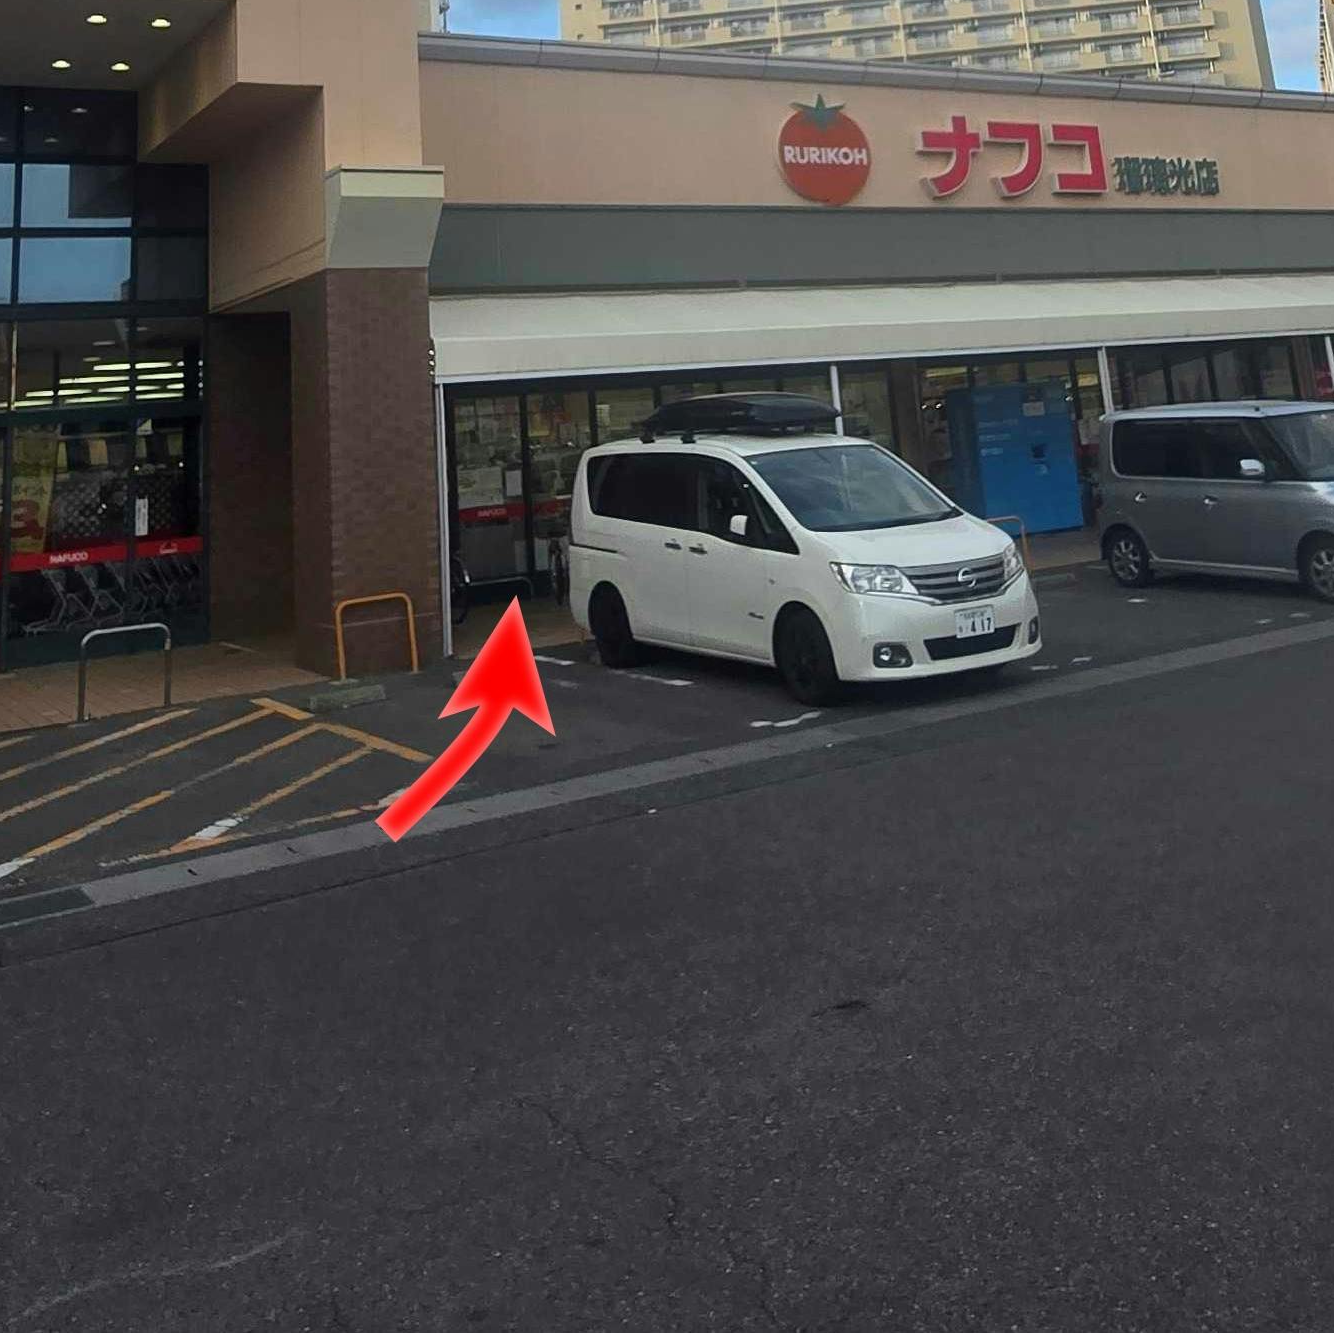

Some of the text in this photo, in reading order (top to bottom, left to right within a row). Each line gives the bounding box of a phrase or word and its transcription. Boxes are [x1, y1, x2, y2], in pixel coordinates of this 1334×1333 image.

[783, 144, 869, 166] RURIKOH
[916, 115, 1108, 199] ナフコ
[49, 551, 89, 565] NAFUCO
